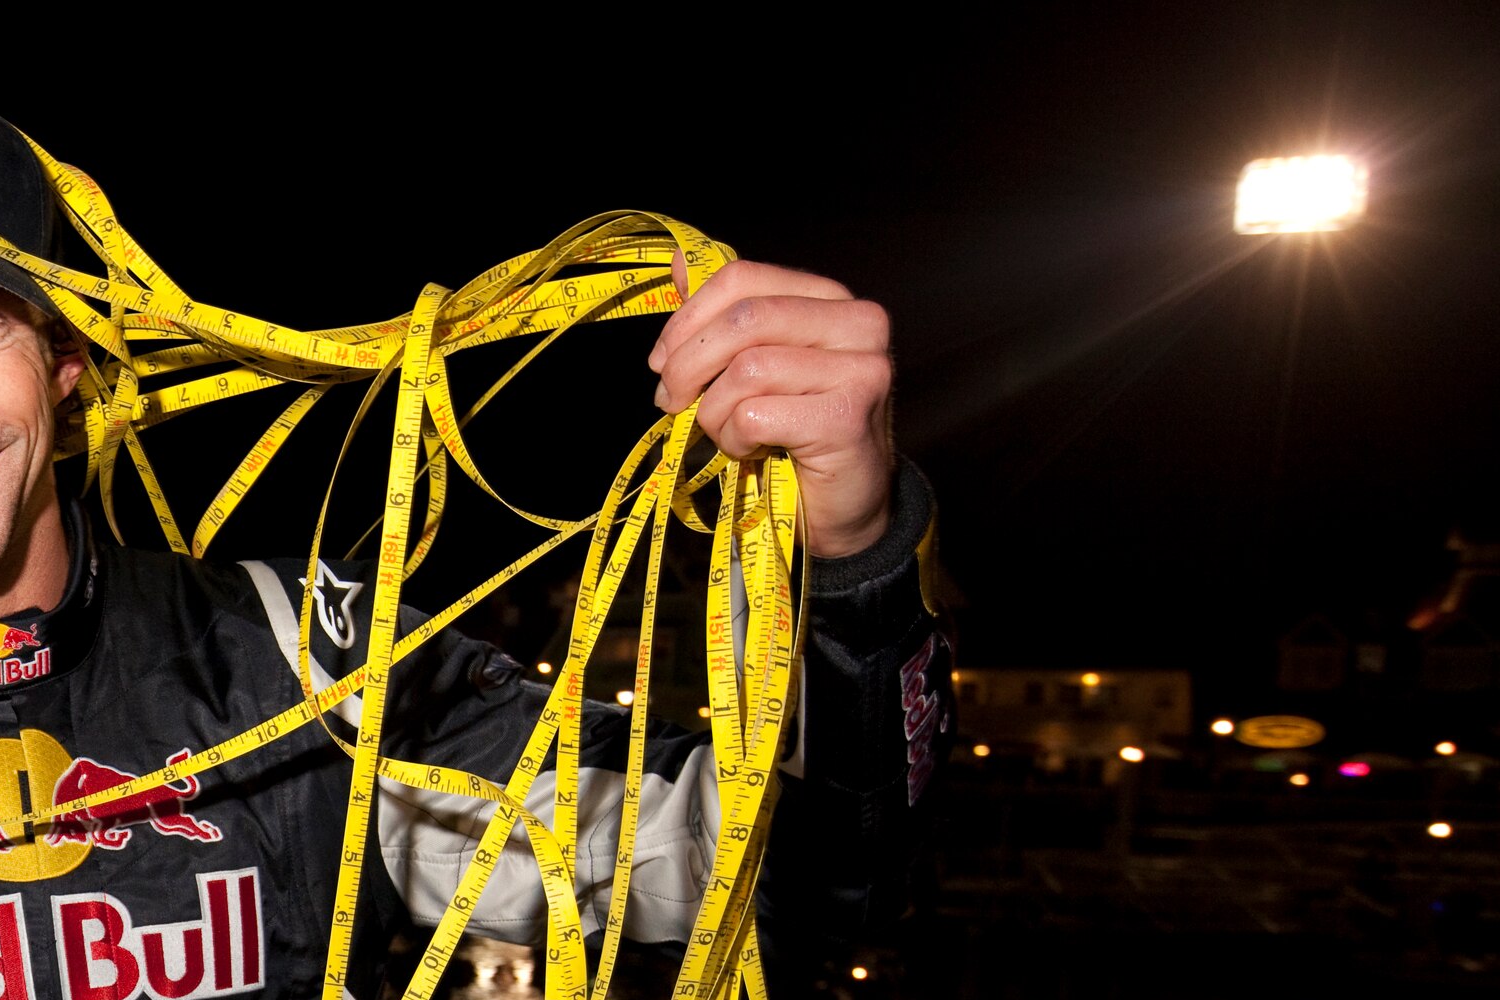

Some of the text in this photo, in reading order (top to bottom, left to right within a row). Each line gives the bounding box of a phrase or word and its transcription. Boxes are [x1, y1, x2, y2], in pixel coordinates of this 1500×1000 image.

[53, 174, 73, 195] 10
[141, 292, 154, 306] 5
[183, 302, 195, 316] 4
[224, 313, 236, 329] 3
[335, 345, 378, 364] 56 ft
[433, 404, 459, 454] 179 ft
[246, 440, 276, 473] 40 ft
[207, 507, 225, 527] 10
[379, 532, 400, 586] 168 ft
[778, 584, 790, 632] 37 ft
[710, 615, 726, 672] 151 ft
[4, 648, 50, 684] Bull
[320, 673, 366, 706] 118 ft
[635, 677, 644, 693] ft
[565, 672, 579, 720] 49 ft
[765, 698, 783, 728] 10
[256, 725, 279, 744] 10
[163, 769, 175, 781] 8
[557, 791, 572, 804] 2
[500, 806, 515, 820] 7
[731, 826, 749, 842] 8
[476, 849, 492, 864] 8
[715, 879, 731, 891] 7
[424, 943, 446, 970] 10
[679, 983, 695, 997] 5
